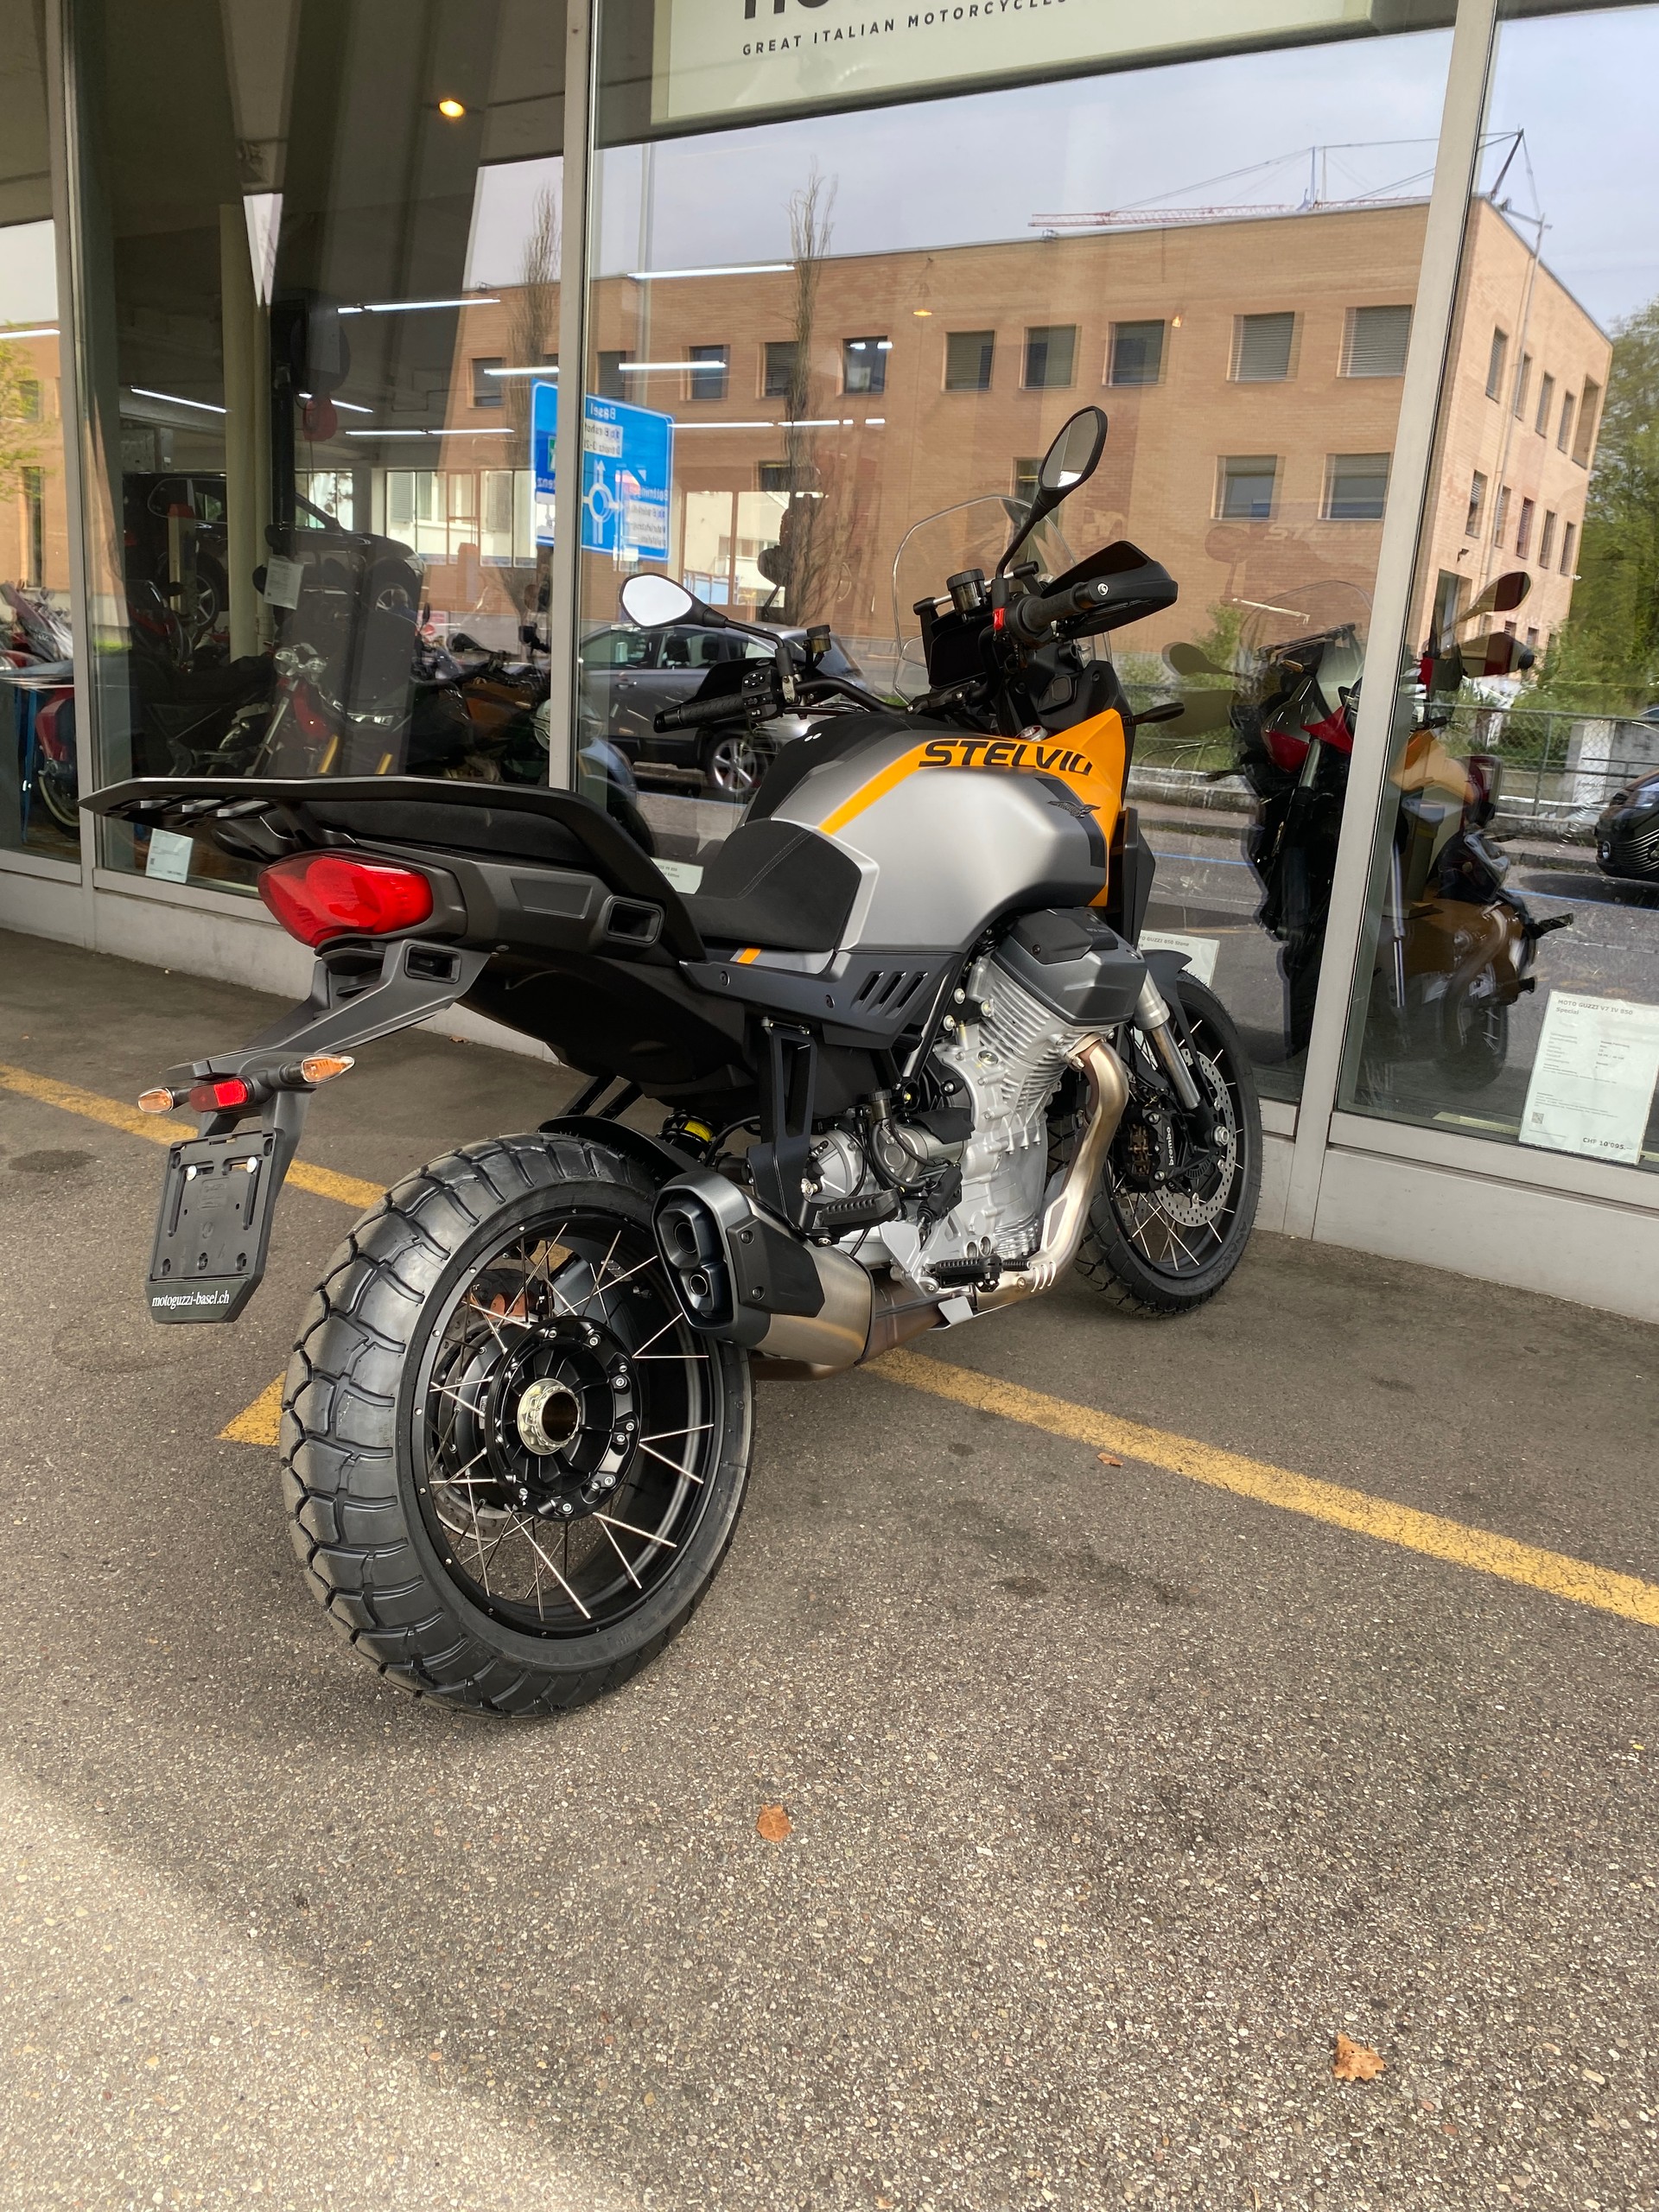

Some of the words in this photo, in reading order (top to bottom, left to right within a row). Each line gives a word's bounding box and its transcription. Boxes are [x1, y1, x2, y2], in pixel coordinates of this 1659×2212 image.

[743, 35, 802, 55] GREAT
[813, 18, 895, 44] ITALIAN
[907, 0, 1066, 29] MOTORCYCL
[918, 740, 1093, 776] STELVIO
[1556, 1007, 1580, 1015] Special
[151, 1289, 230, 1310] motoguzzi-basel.ch
